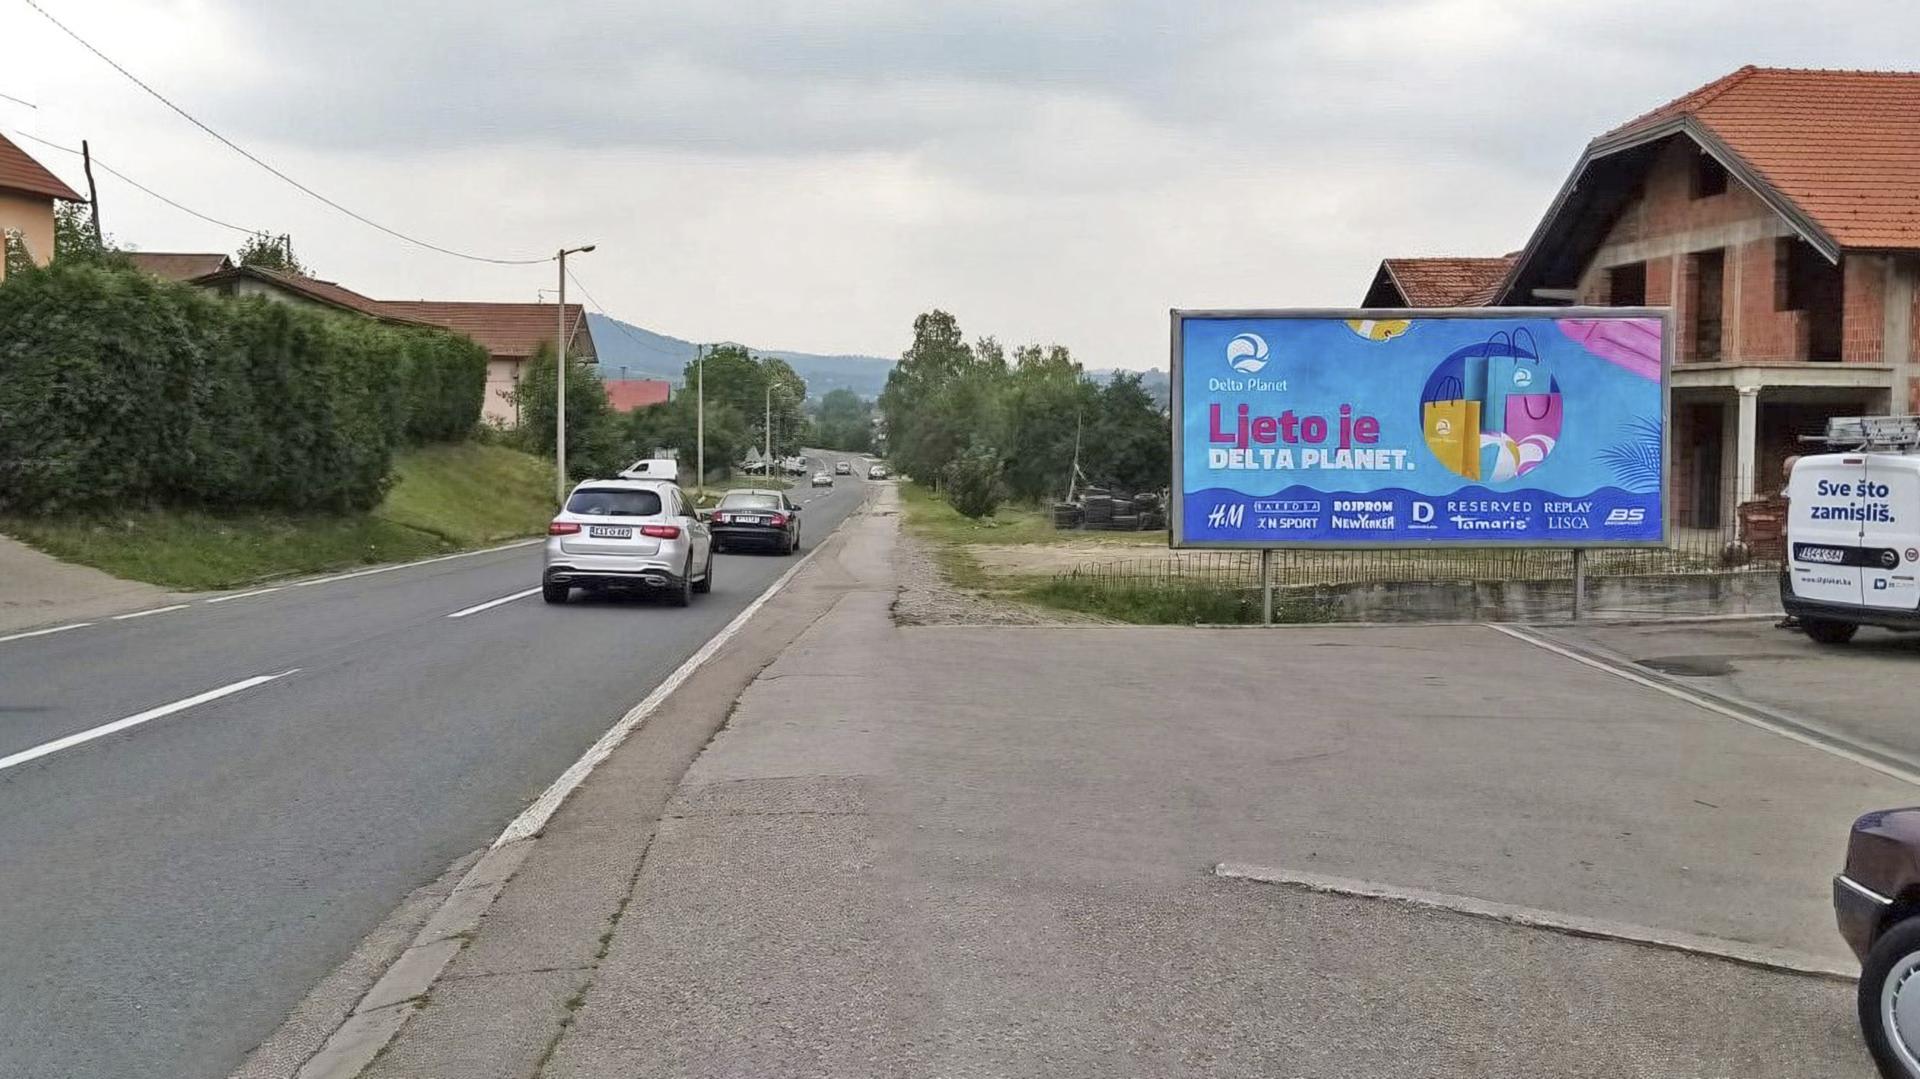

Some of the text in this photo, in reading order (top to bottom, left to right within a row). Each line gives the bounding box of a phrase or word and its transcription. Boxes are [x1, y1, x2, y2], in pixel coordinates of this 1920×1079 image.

[1208, 378, 1288, 392] Delta Planet
[1209, 403, 1381, 456] Ljeto je
[1208, 448, 1416, 471] DELTA PLANET.
[1818, 479, 1889, 498] Sve što
[1447, 501, 1532, 513] RESERVED
[1543, 502, 1593, 513] REPLAY
[1810, 502, 1895, 523] zamisliš.
[1279, 518, 1319, 529] SPORT
[1548, 516, 1590, 529] LISCA
